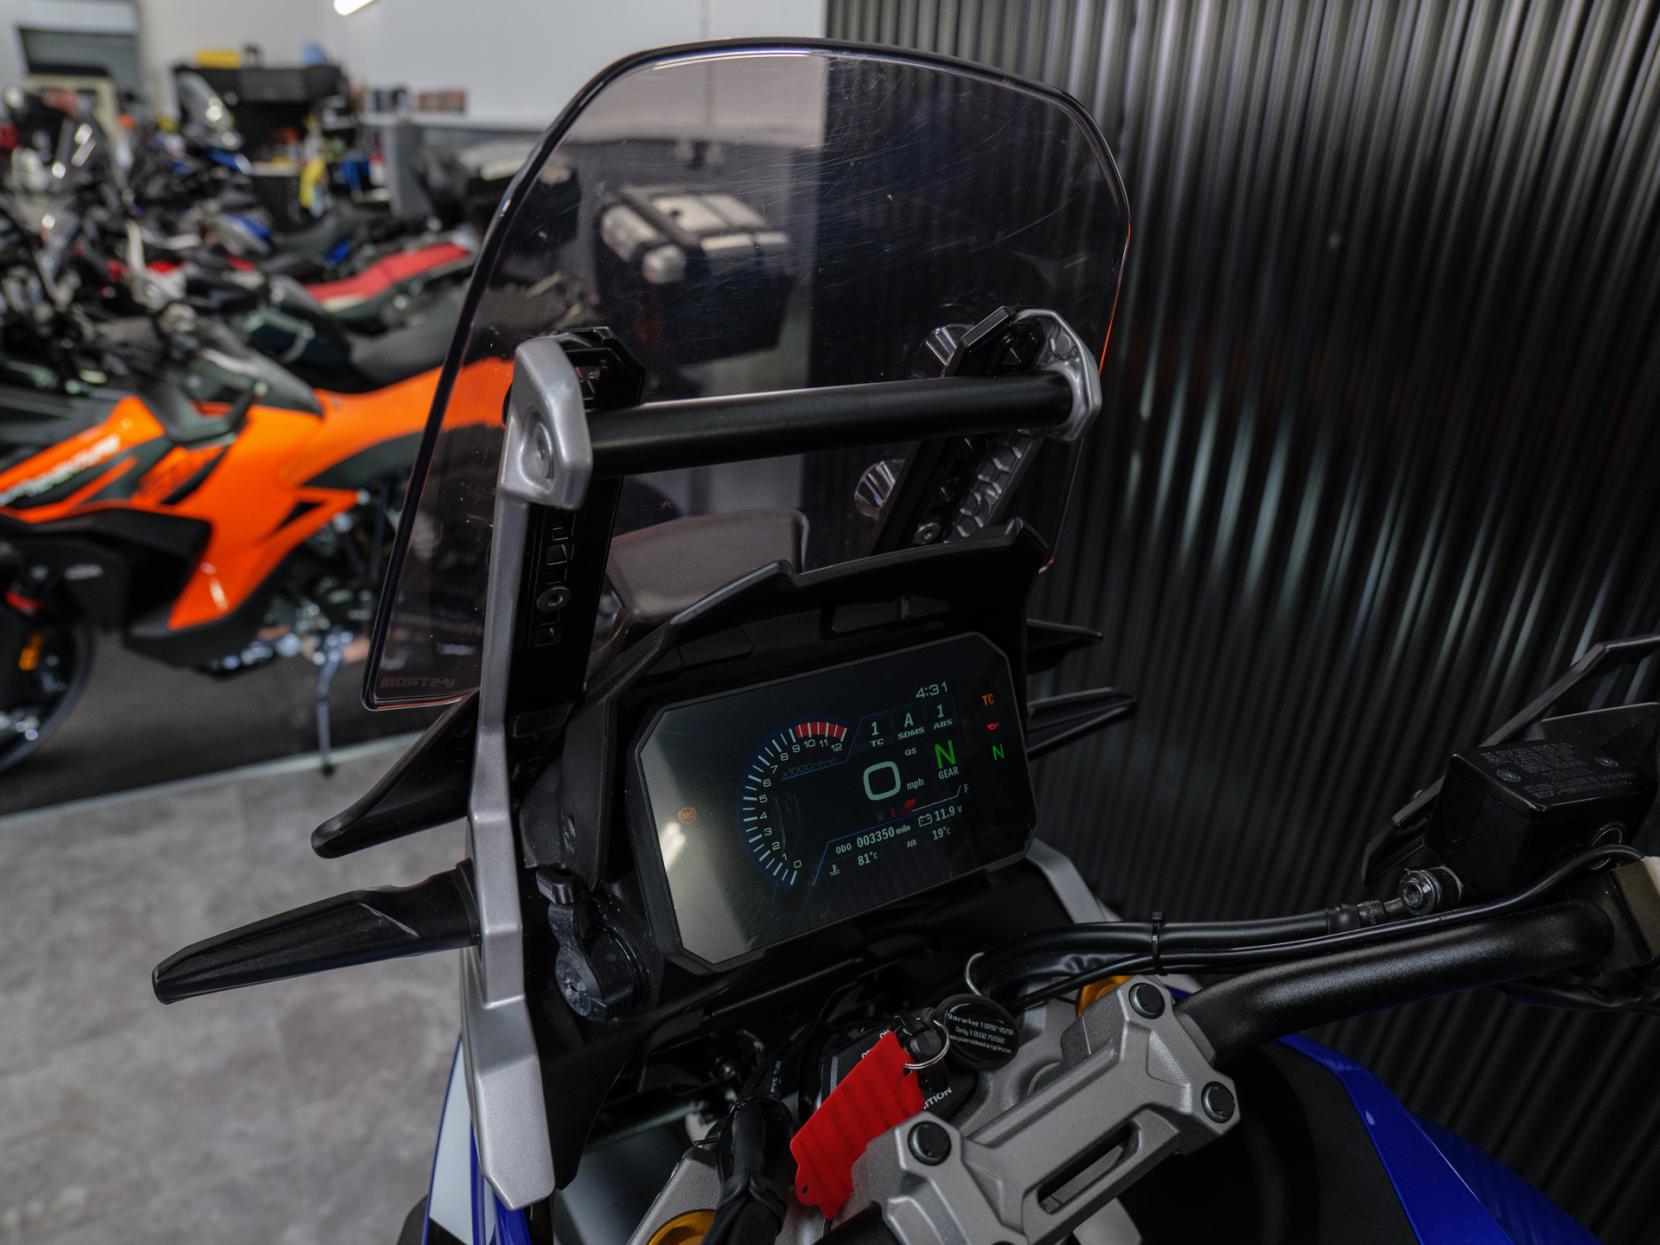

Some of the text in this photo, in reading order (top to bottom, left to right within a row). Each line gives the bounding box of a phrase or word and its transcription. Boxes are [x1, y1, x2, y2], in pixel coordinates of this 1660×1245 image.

[915, 681, 949, 698] 4:31
[981, 693, 995, 706] TC
[937, 704, 944, 718] 1
[904, 712, 914, 728] A
[933, 718, 953, 730] ABS
[871, 721, 879, 736] 1
[898, 727, 925, 740] SDMS
[792, 744, 800, 753] 9
[804, 739, 816, 748] 10
[820, 739, 829, 748] 11
[831, 742, 843, 752] 12
[870, 738, 884, 748] TC
[780, 752, 789, 761] 8
[934, 740, 957, 769] N
[992, 743, 1005, 761] N
[769, 764, 778, 774] 7
[938, 766, 960, 780] GEAR
[763, 779, 772, 788] 6
[863, 760, 901, 801] 0
[906, 777, 925, 791] mph
[963, 783, 970, 794] F
[759, 794, 768, 803] 5
[760, 812, 768, 820] 4
[935, 805, 956, 823] 11.9
[763, 827, 772, 836] 3
[772, 841, 780, 850] 2
[835, 843, 852, 855] ODO
[856, 826, 895, 848] 003350
[906, 839, 918, 849] AIR
[782, 852, 788, 861] 1
[793, 860, 802, 869] 0
[923, 1086, 952, 1110] ITION
